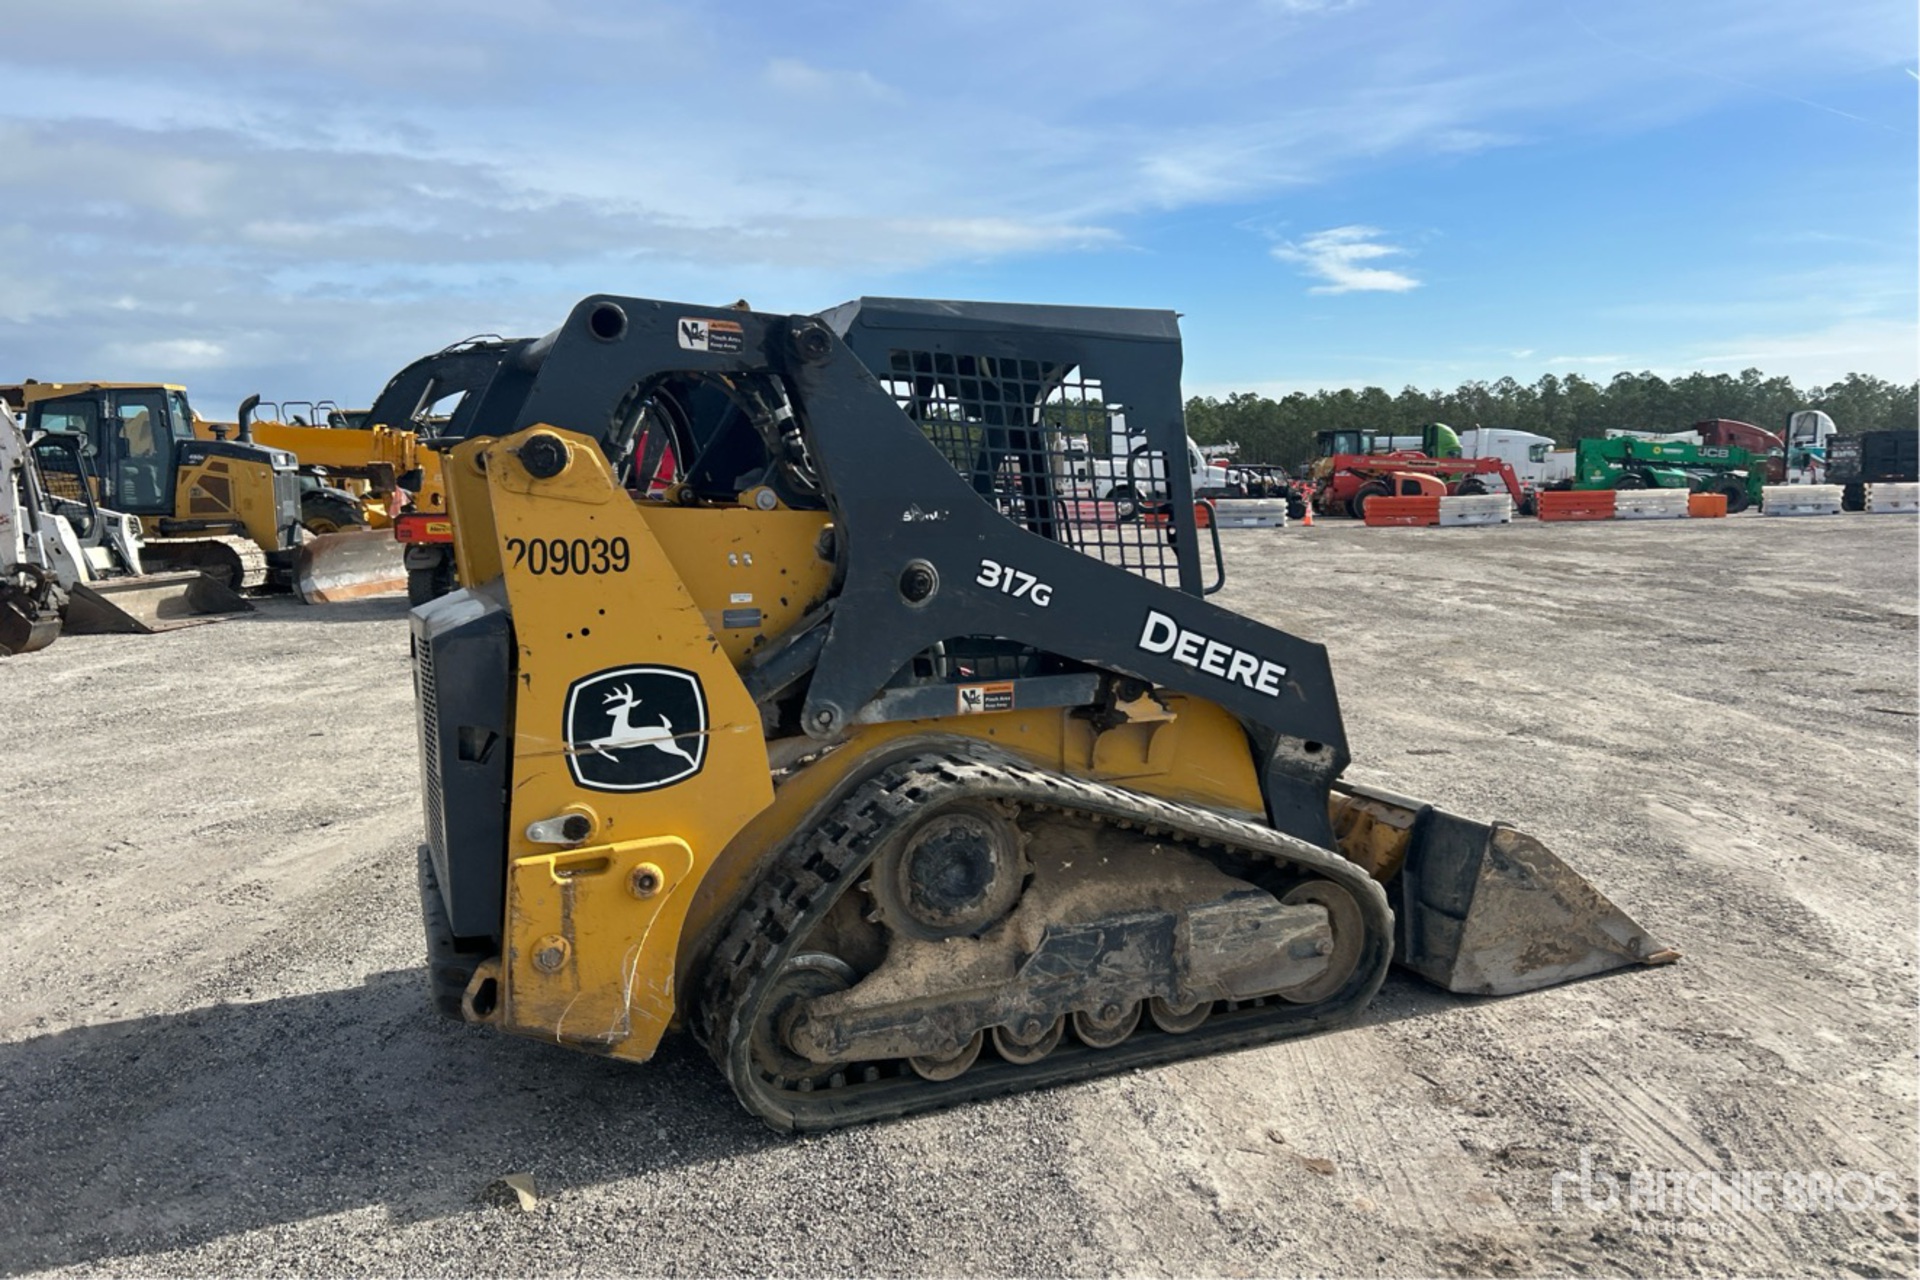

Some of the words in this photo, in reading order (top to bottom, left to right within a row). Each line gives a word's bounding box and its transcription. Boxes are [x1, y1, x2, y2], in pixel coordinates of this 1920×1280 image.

[1697, 447, 1730, 458] JCB
[506, 536, 630, 575] 209039
[976, 559, 1053, 607] 317G
[1138, 610, 1287, 697] DEERE
